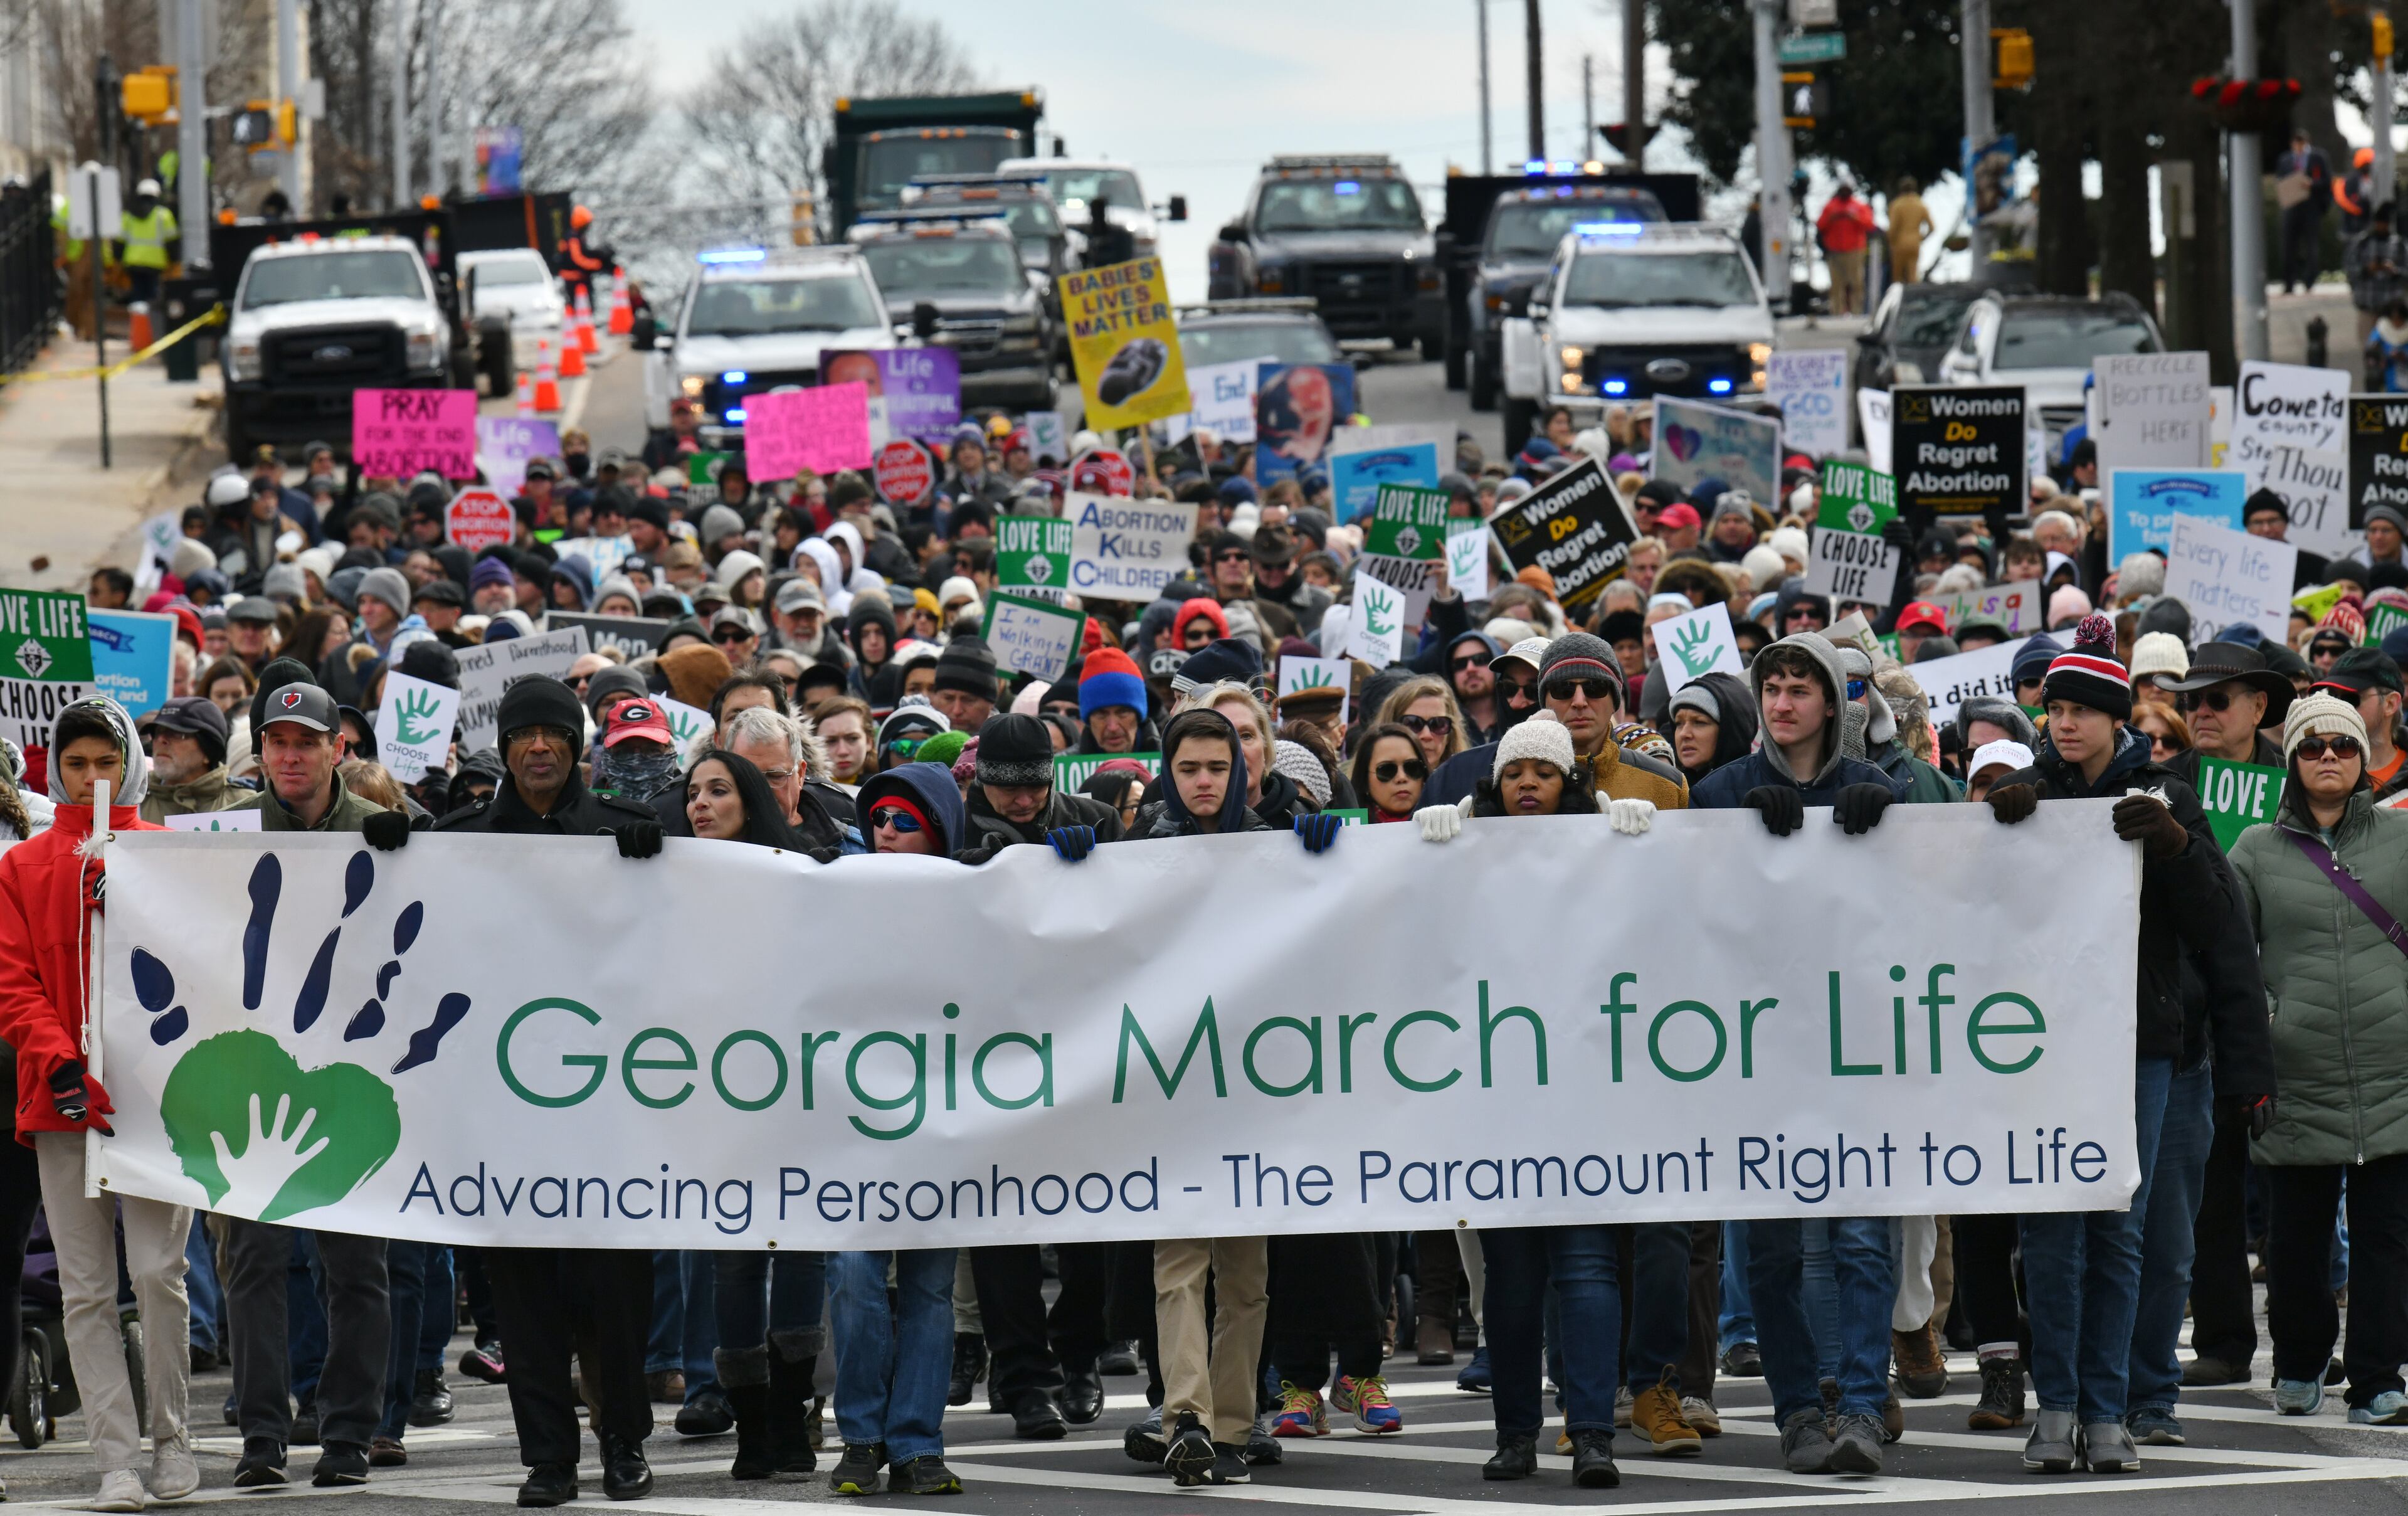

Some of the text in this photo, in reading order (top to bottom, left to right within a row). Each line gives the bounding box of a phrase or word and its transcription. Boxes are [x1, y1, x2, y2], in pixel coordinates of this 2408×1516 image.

[1082, 285, 1150, 314] LIVES
[1074, 304, 1169, 337] MATTER
[887, 350, 934, 378] Life
[2110, 355, 2196, 374] RECYCLE
[382, 391, 448, 422] PRAY
[1931, 396, 2020, 417] Women
[2110, 382, 2205, 407] BOTTLES
[2243, 373, 2344, 419] Coweta
[489, 419, 532, 445] Life
[1945, 421, 1977, 442] Do
[2140, 419, 2192, 444] HERE
[362, 449, 468, 474] ABORTION
[1918, 442, 1999, 469] Regret
[2273, 442, 2343, 491] Thou
[1825, 464, 1896, 509] LOVE LIFE
[1904, 470, 2010, 492] Abortion
[460, 500, 500, 517] STOP
[1376, 487, 1415, 523] LOVE
[1417, 492, 1449, 527] LIFE
[1521, 471, 1603, 526] Women
[452, 519, 510, 531] ABORTION
[1078, 502, 1188, 532] ABORTION
[1548, 515, 1578, 542] Do
[2128, 511, 2150, 528] To
[998, 520, 1072, 555] LOVE LIFE
[1099, 533, 1162, 559] KILLS
[1535, 519, 1608, 573] Regret
[1822, 533, 1889, 569] CHOOSE
[2173, 523, 2271, 582] Every life
[1368, 556, 1435, 591] CHOOSE
[1831, 566, 1869, 597] LIFE
[1977, 596, 2000, 614] is
[2188, 579, 2261, 618] matters
[0, 594, 84, 639] VE LIFE
[998, 608, 1018, 623] I
[507, 633, 578, 662] Parenthood
[593, 630, 649, 657] Men
[1360, 630, 1391, 650] CHOOSE
[1010, 647, 1065, 675] GRANT
[119, 691, 148, 704] and
[1946, 678, 1989, 704] did
[1995, 674, 2013, 694] it
[386, 742, 430, 762] CHOOSE
[393, 756, 420, 777] Life
[2202, 765, 2268, 819] LOVE
[497, 963, 2047, 1140] Georgia March for Life
[399, 1162, 752, 1235] Advancing
[779, 1156, 1158, 1222] Personhood
[1222, 1152, 1334, 1208] The
[1360, 1137, 1714, 1204] Paramount
[1738, 1132, 1897, 1204] Right
[1919, 1132, 1982, 1187] to
[2007, 1127, 2108, 1185] Life
